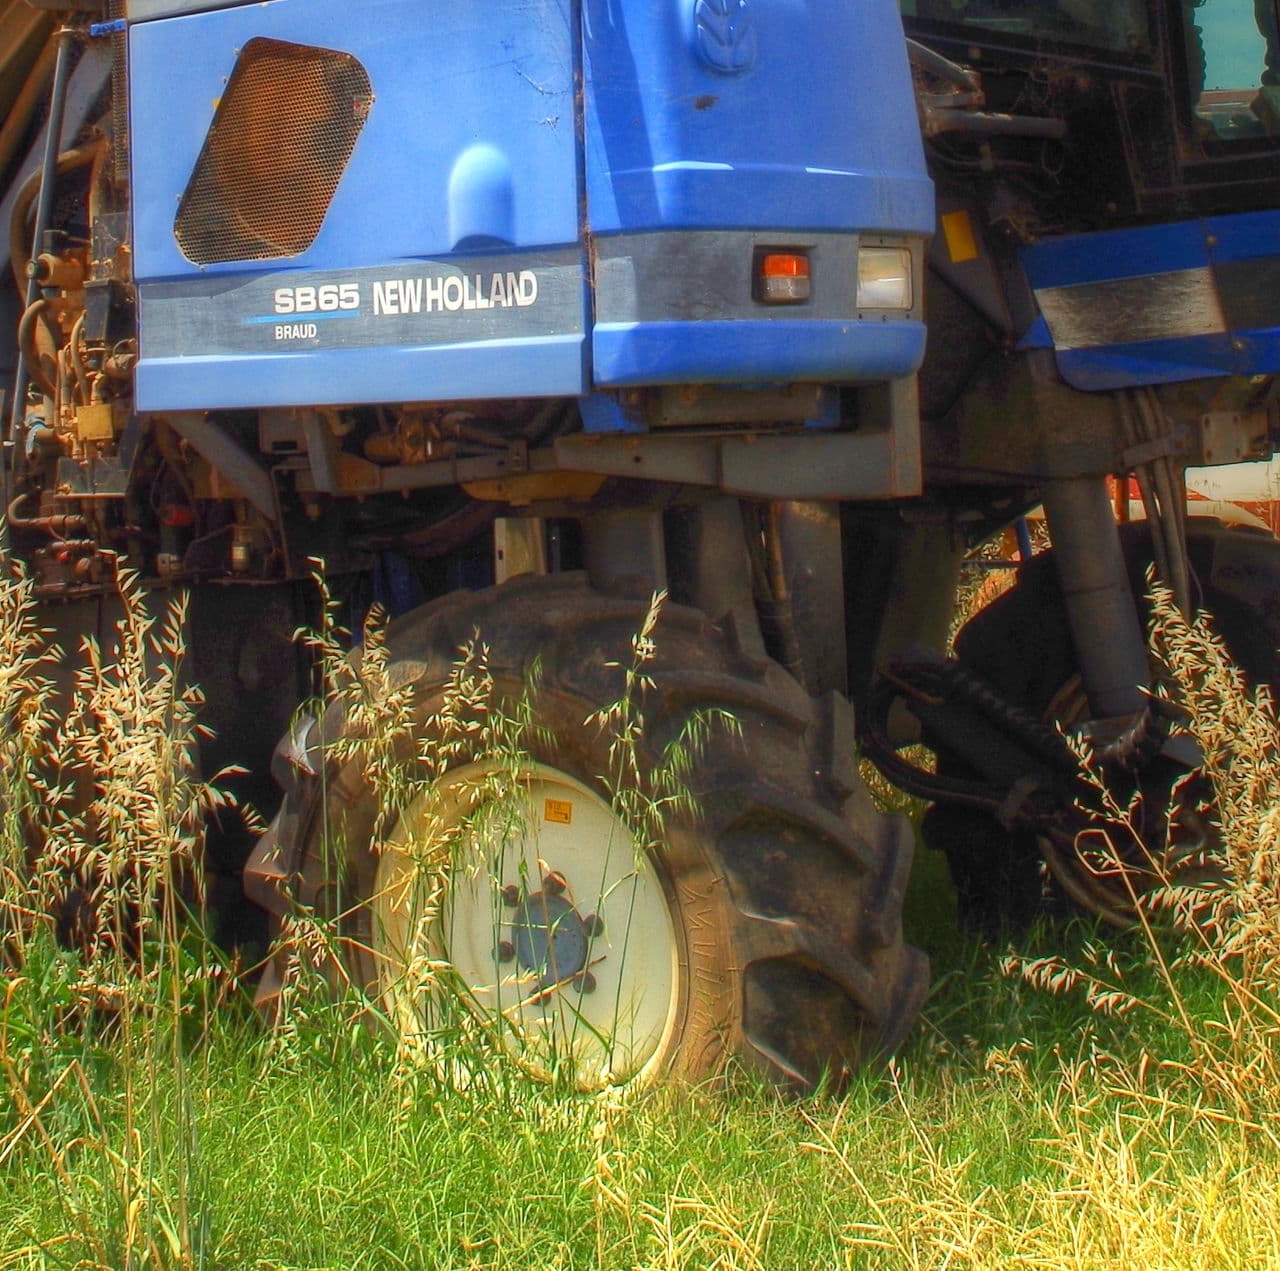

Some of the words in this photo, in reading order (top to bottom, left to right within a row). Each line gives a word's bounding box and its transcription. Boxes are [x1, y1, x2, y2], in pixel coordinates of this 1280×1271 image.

[274, 283, 360, 314] SB65
[372, 278, 423, 316] NEW
[426, 270, 539, 313] HOLLAND
[275, 323, 317, 340] BRAUD
